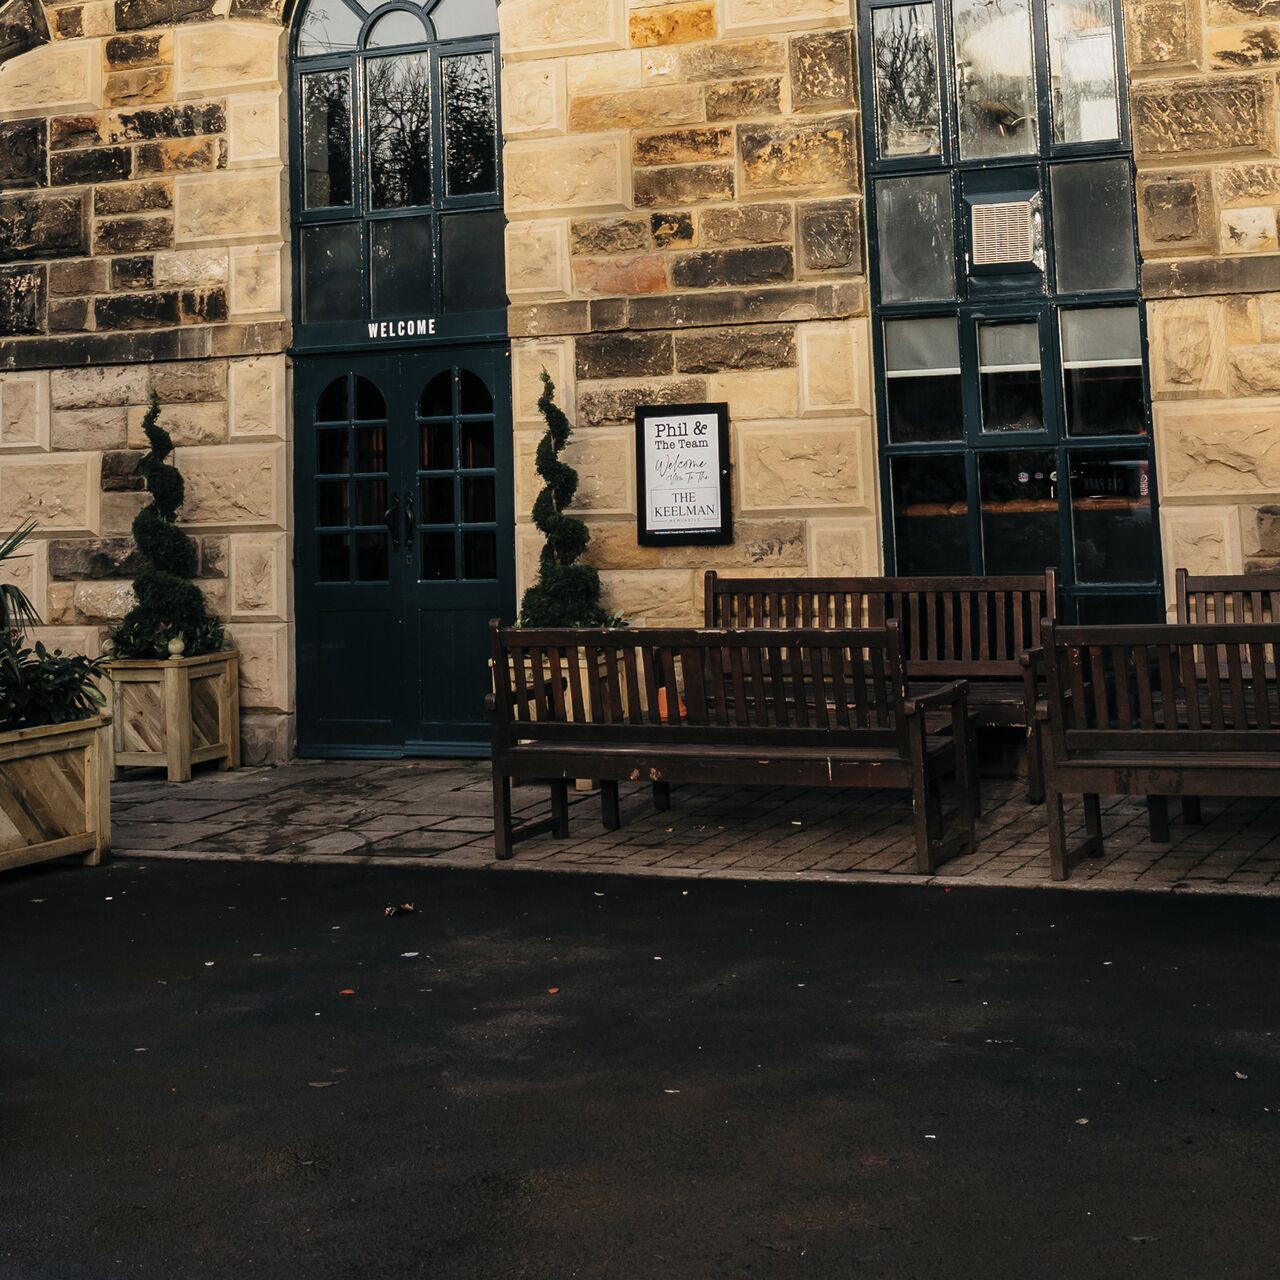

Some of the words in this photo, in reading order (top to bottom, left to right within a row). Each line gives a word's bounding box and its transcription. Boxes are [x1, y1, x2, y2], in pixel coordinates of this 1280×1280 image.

[368, 319, 435, 338] WELCOME
[655, 422, 688, 438] Phil
[693, 421, 708, 435] &
[655, 440, 675, 450] The
[678, 438, 709, 449] Team
[655, 454, 707, 477] Welcome
[672, 492, 696, 503] THE
[655, 504, 715, 517] KEELMAN
